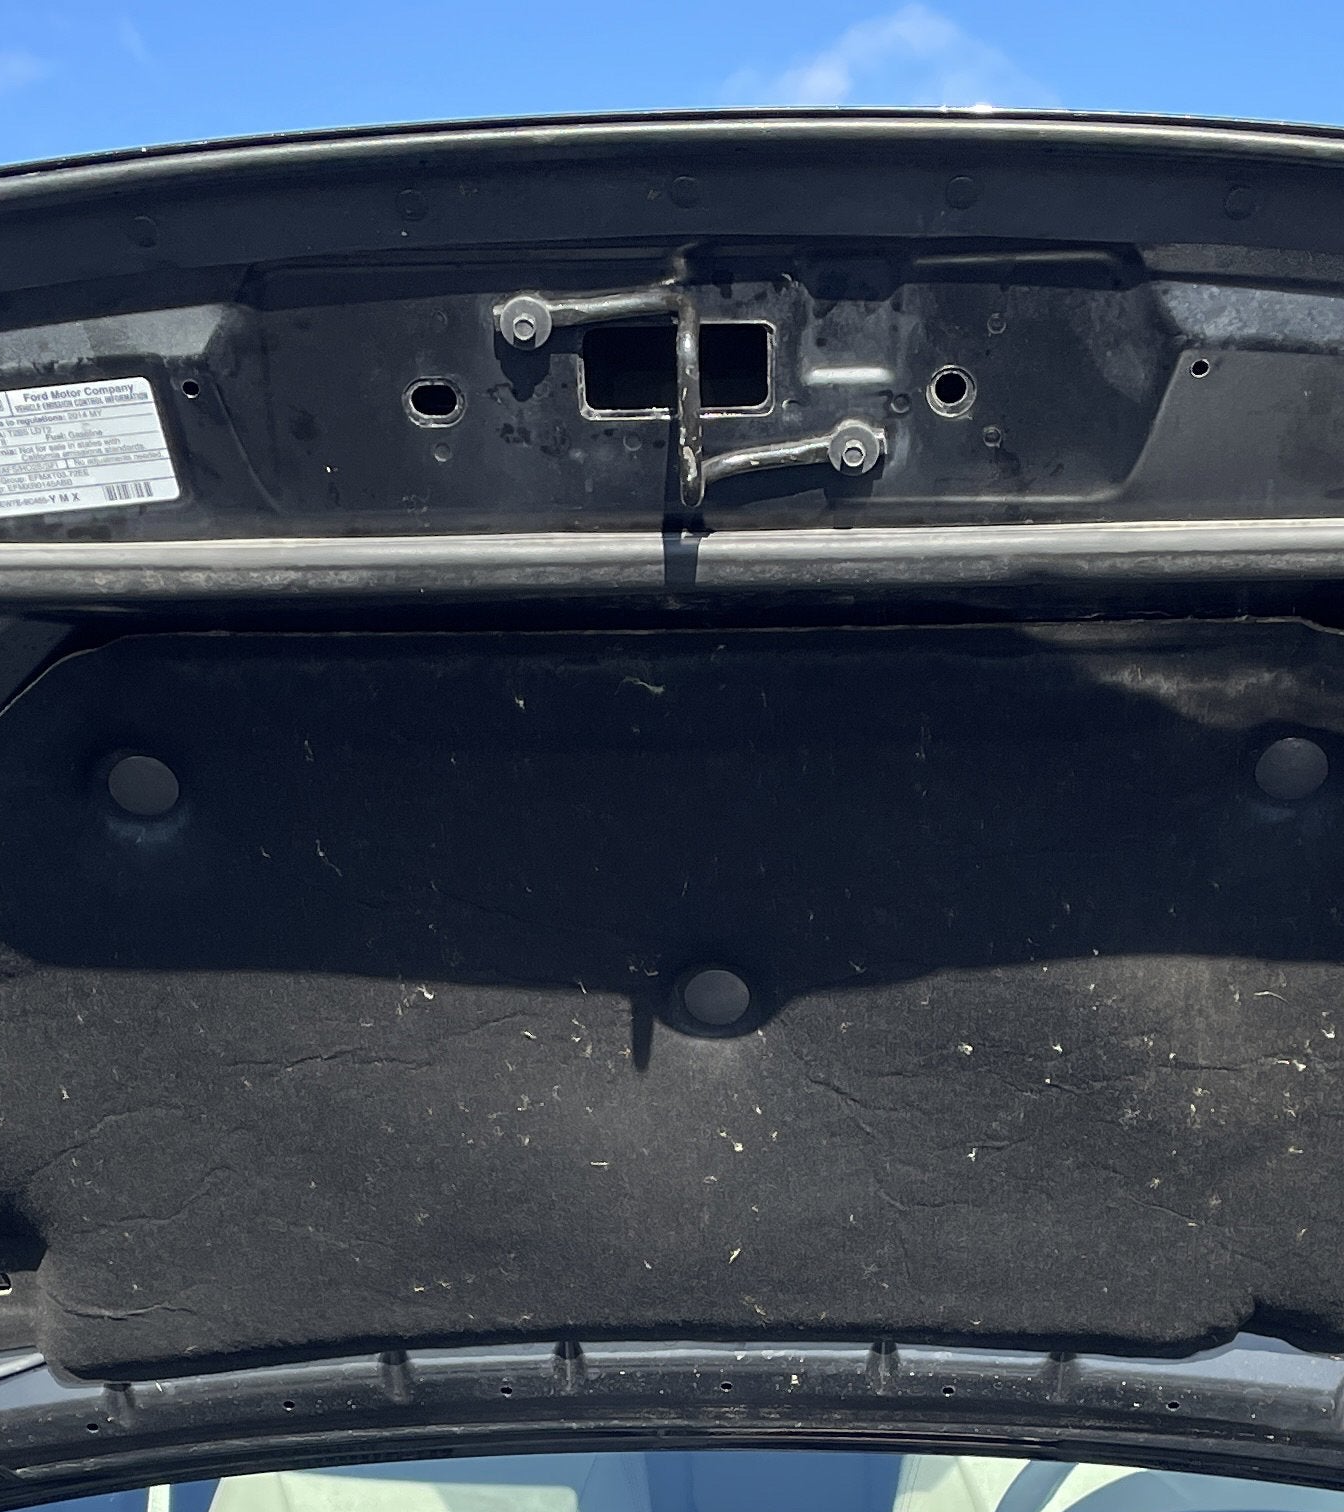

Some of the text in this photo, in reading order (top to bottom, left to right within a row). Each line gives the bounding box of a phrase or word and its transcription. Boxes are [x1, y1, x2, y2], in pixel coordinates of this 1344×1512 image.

[23, 384, 134, 402] Ford Motor Company
[6, 419, 15, 427] to
[17, 414, 65, 425] regulations:
[67, 411, 87, 420] 2014
